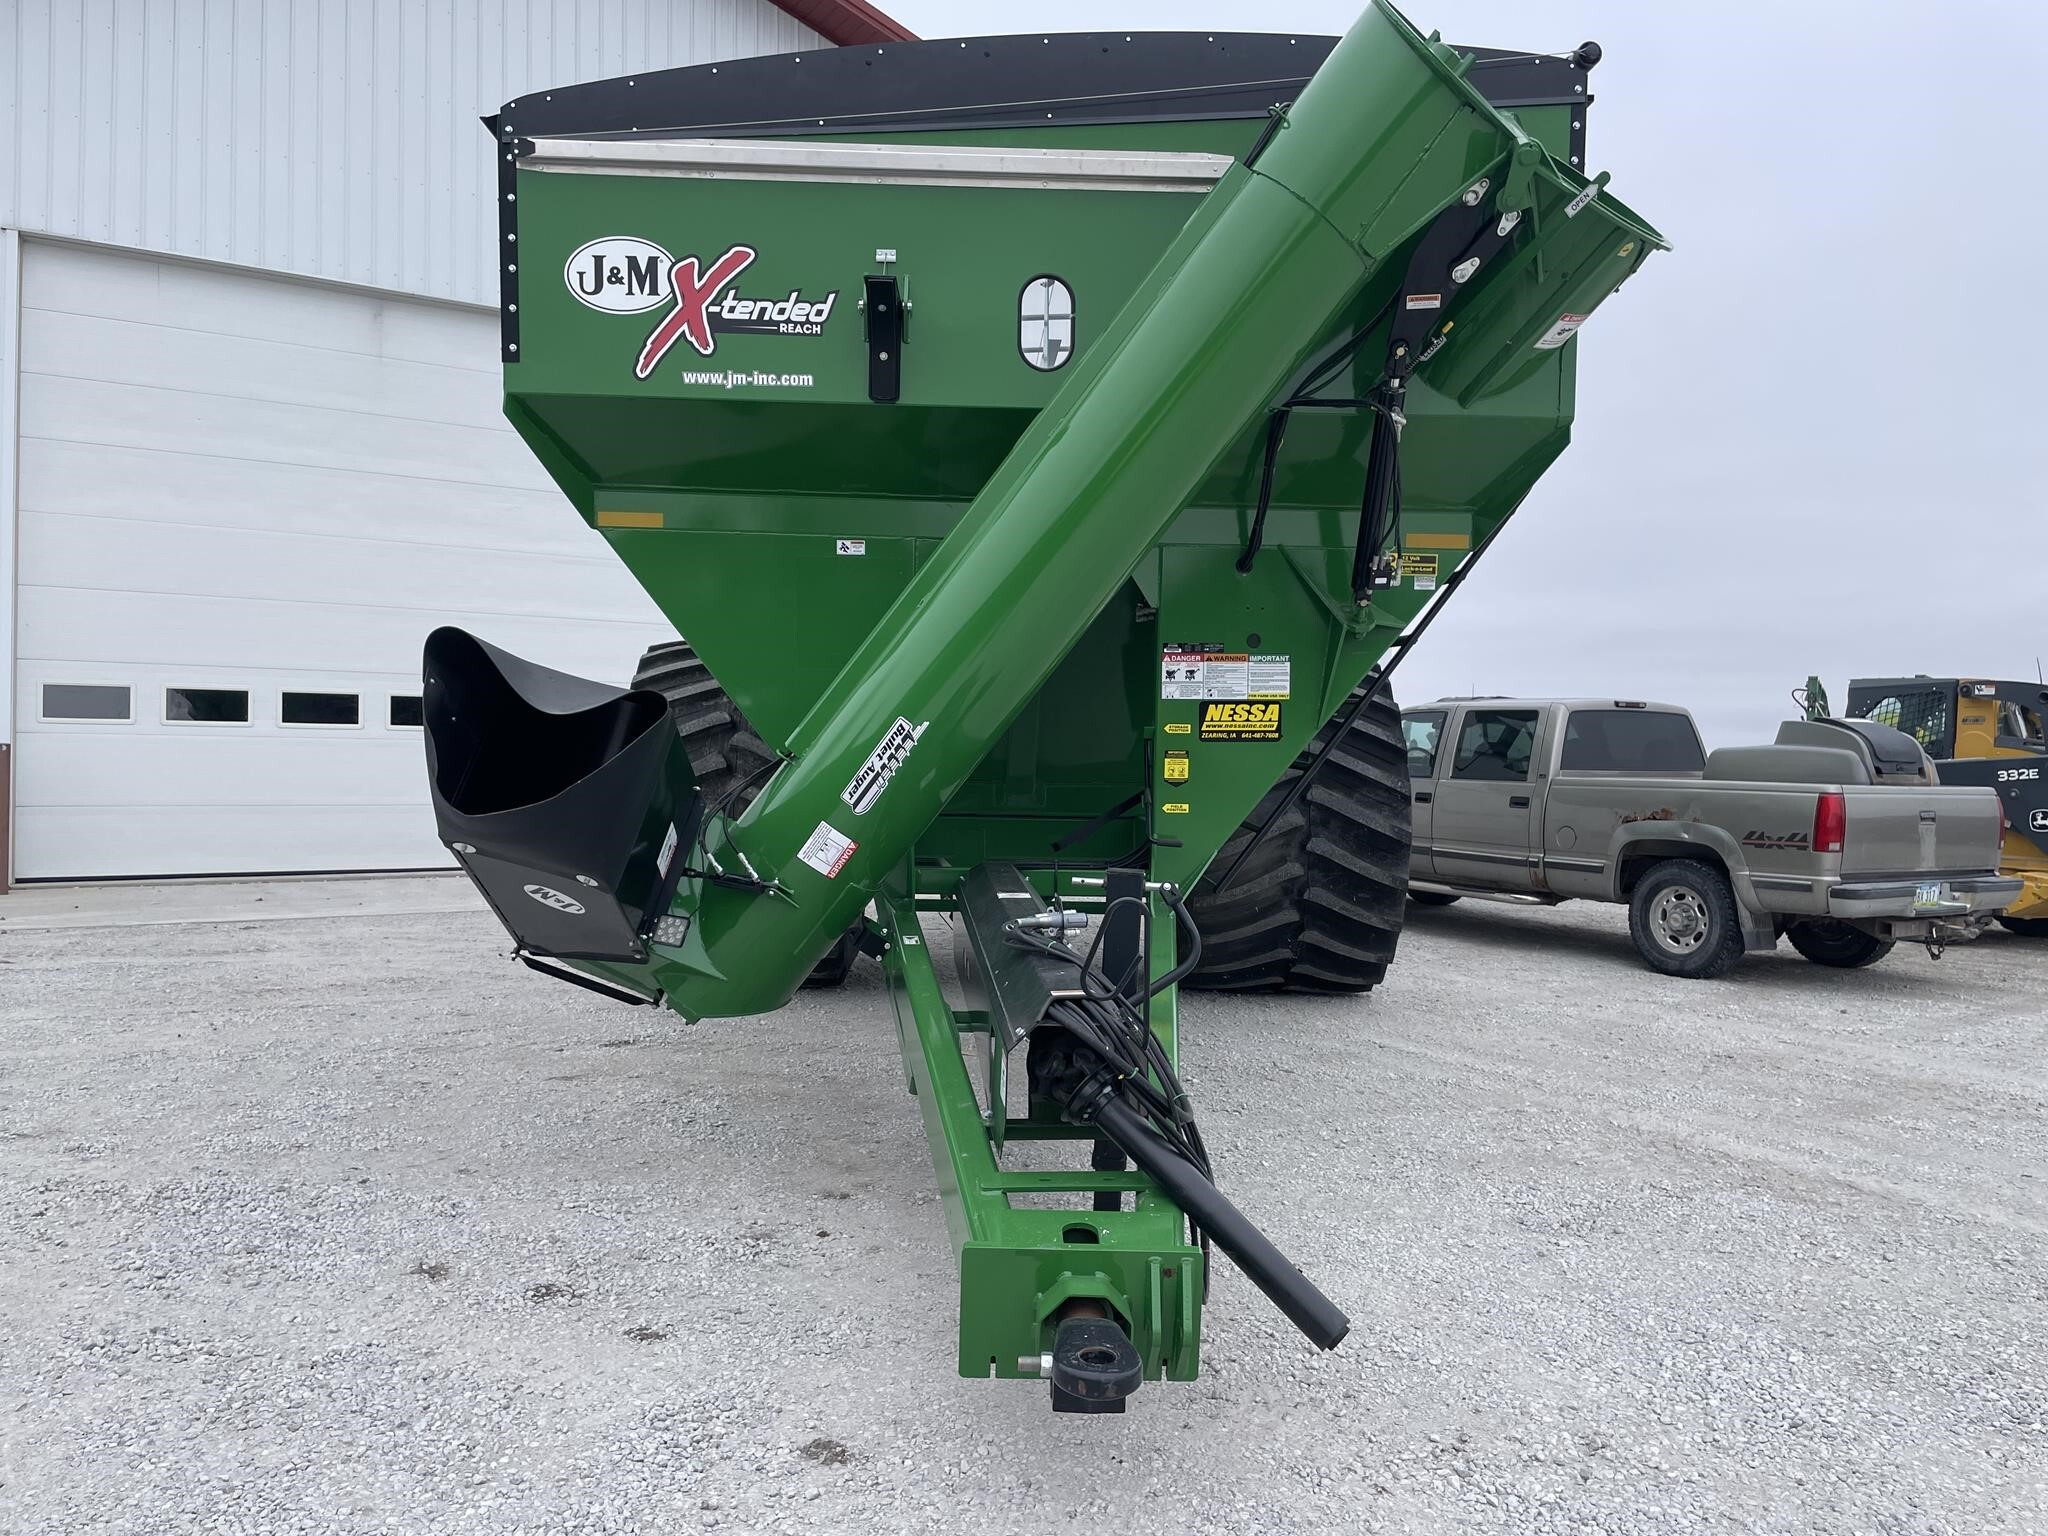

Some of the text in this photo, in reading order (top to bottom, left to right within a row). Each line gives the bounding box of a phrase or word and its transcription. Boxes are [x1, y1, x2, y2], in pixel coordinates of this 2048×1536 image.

[1571, 192, 1590, 211] OPEN
[576, 254, 661, 297] J&M
[779, 323, 821, 335] REACH
[682, 370, 813, 388] www.jm-inc.com
[1205, 704, 1280, 721] NESSA
[848, 723, 906, 800] Bullet Auger
[1997, 768, 2040, 781] 332E
[1742, 830, 1809, 850] 4x4
[828, 849, 857, 879] DANGER
[528, 886, 584, 913] J&M
